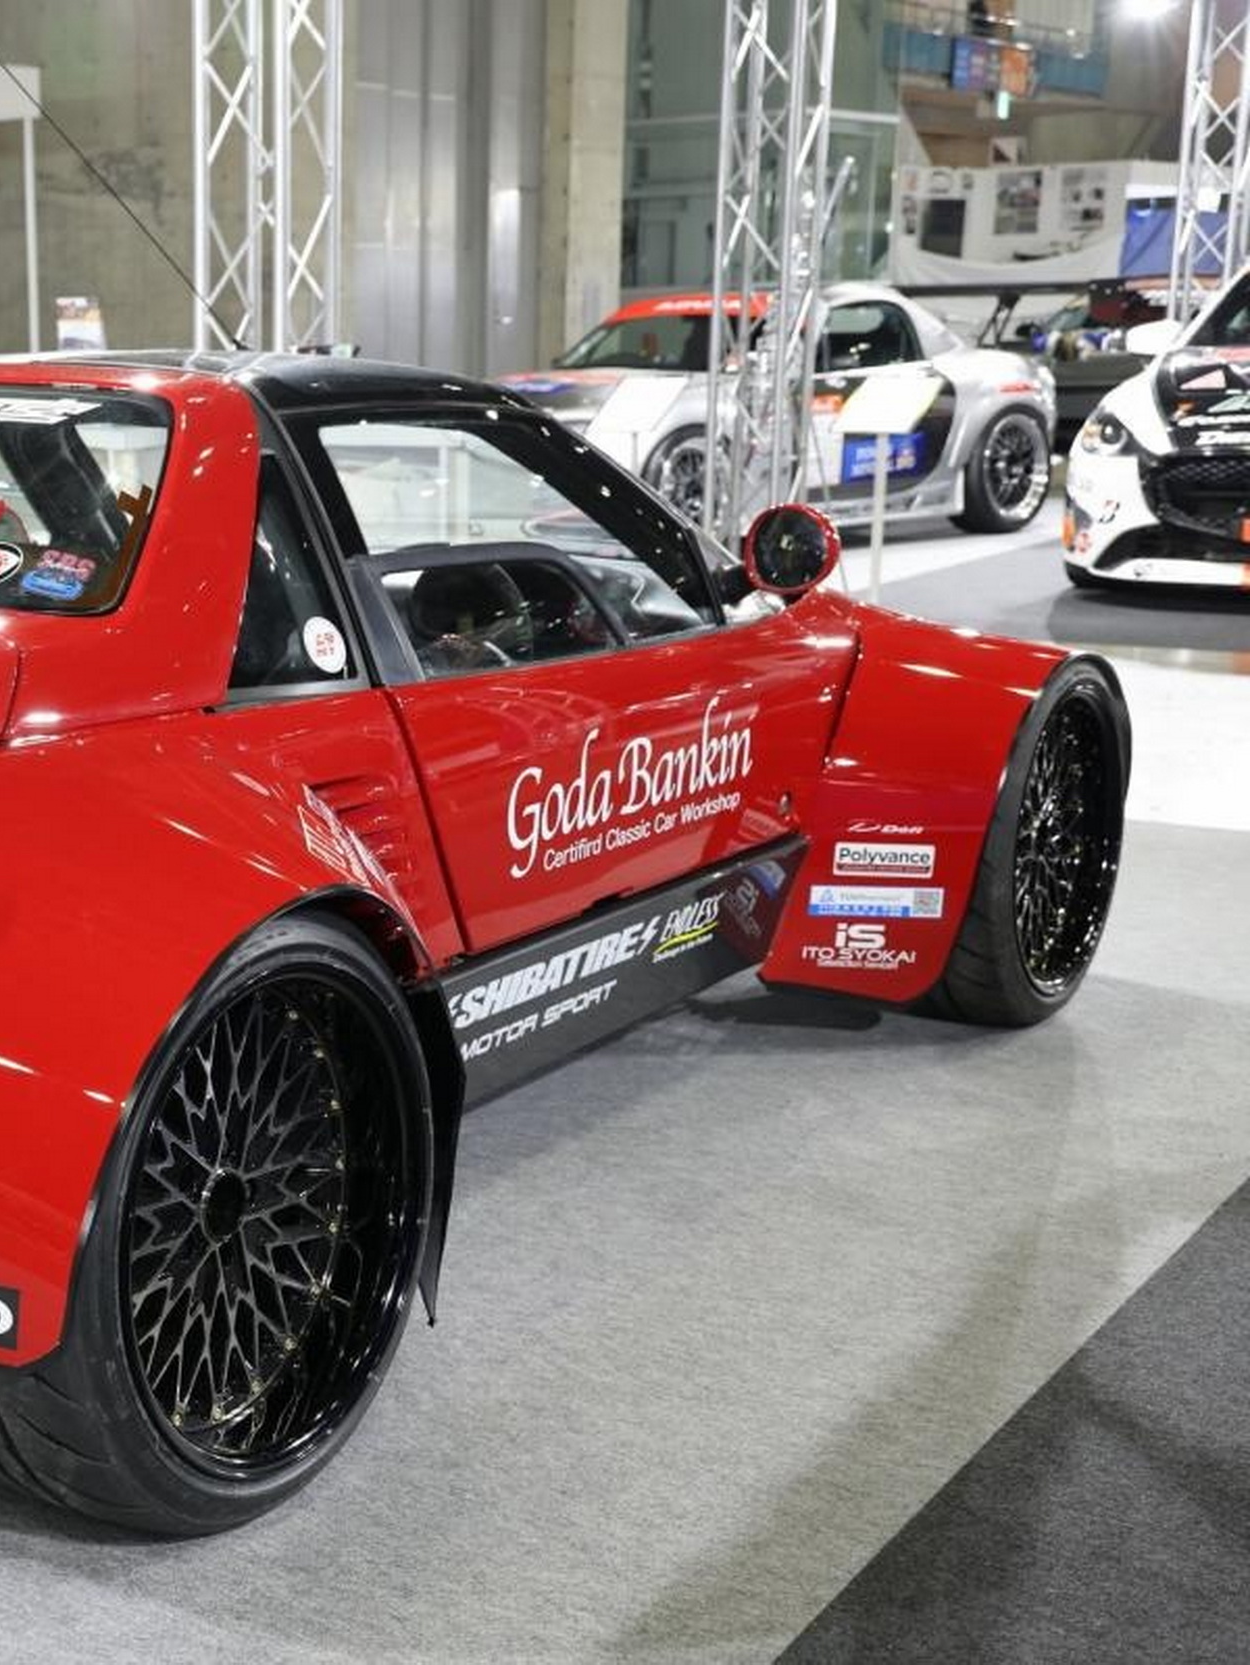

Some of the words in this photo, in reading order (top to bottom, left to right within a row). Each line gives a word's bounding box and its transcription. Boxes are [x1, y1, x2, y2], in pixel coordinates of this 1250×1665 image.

[507, 728, 613, 879] Goda
[618, 696, 753, 815] Bankin
[605, 820, 652, 851] Classic
[653, 812, 678, 834] Car
[680, 791, 741, 824] Workshop
[839, 847, 931, 865] Polyvance
[801, 945, 835, 960] ITO
[836, 947, 917, 964] SYOKAI
[460, 1013, 538, 1062] MOTOR
[542, 979, 618, 1028] SPORT
